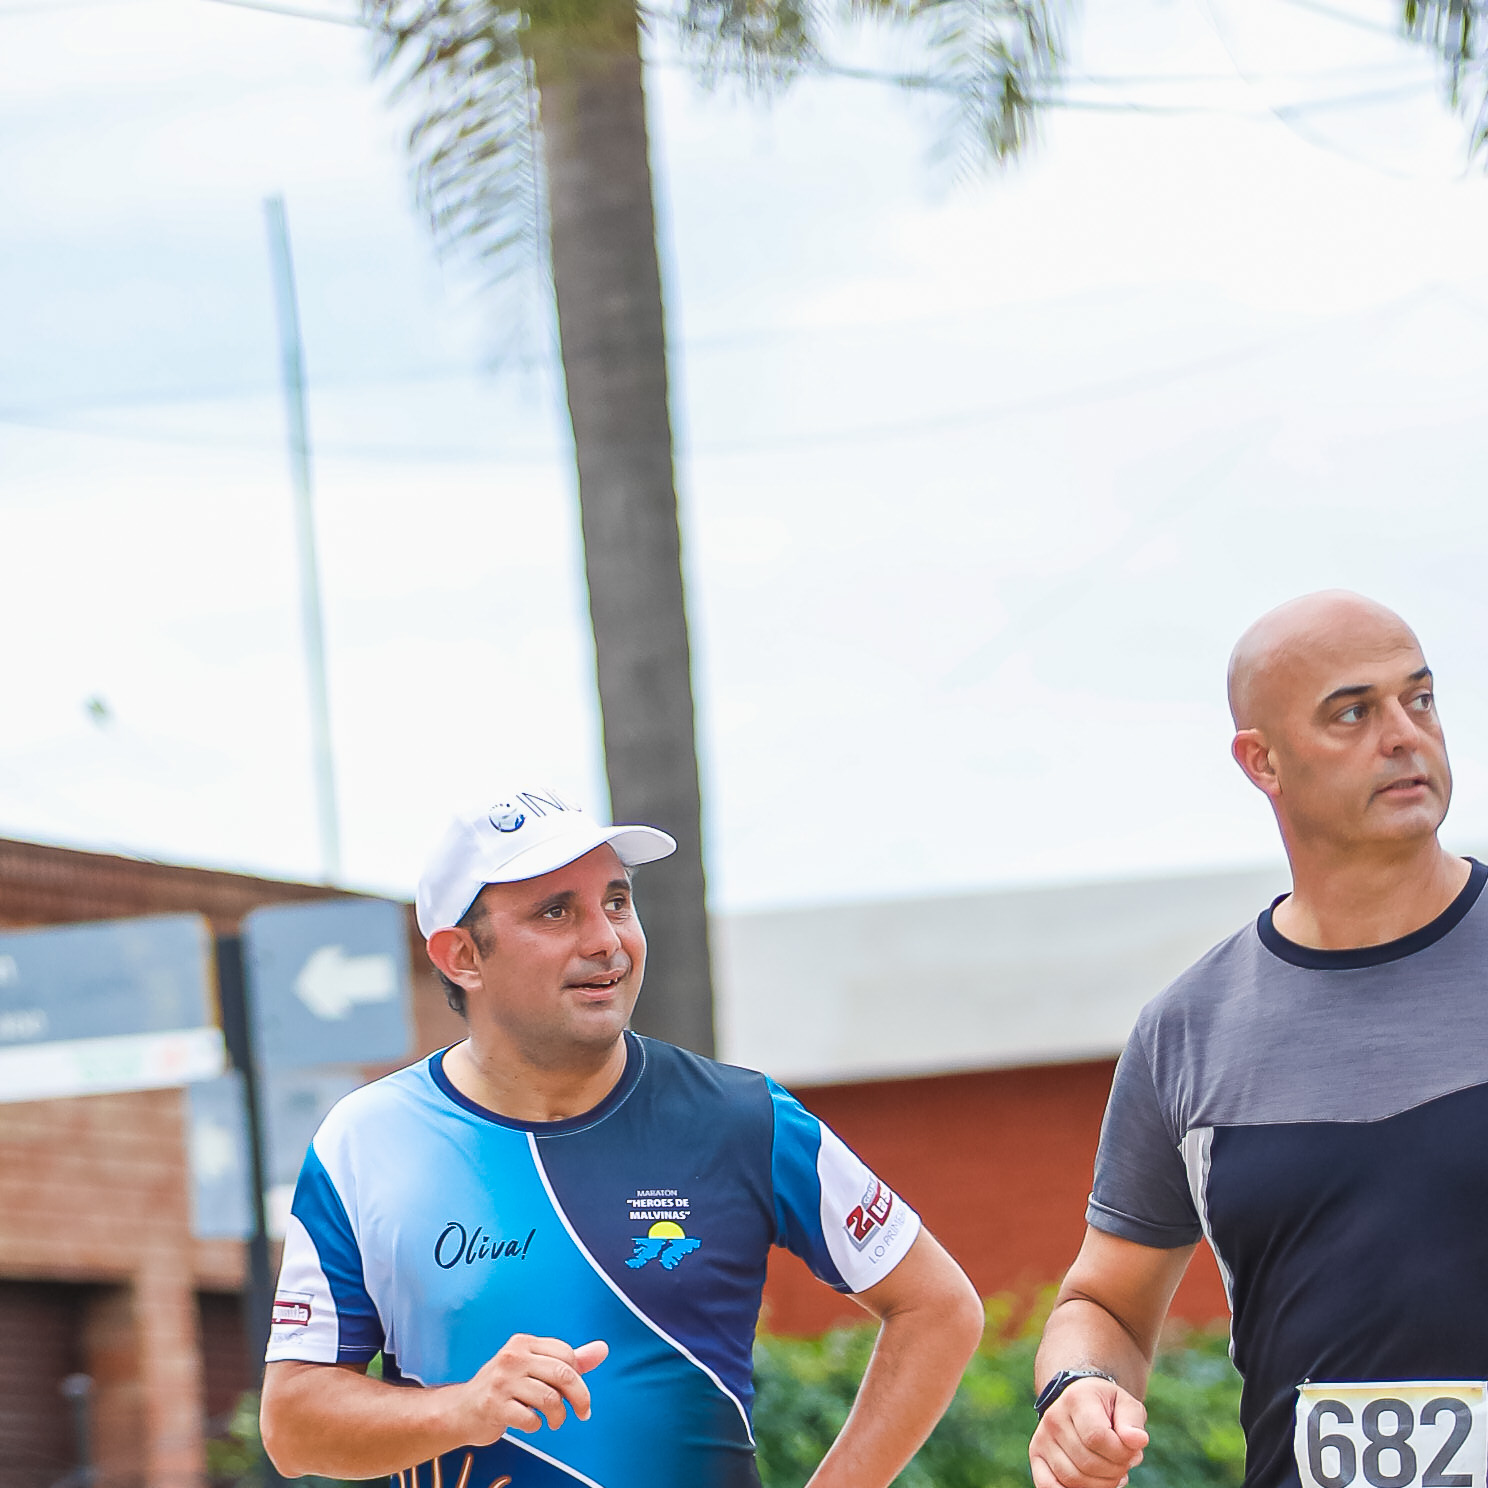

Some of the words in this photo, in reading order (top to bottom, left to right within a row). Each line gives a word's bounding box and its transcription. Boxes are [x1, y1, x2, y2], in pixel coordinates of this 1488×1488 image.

[627, 1198, 673, 1208] "HEROES
[675, 1198, 690, 1208] DE
[629, 1210, 691, 1220] MALVINAS"
[434, 1221, 536, 1269] Oliva!
